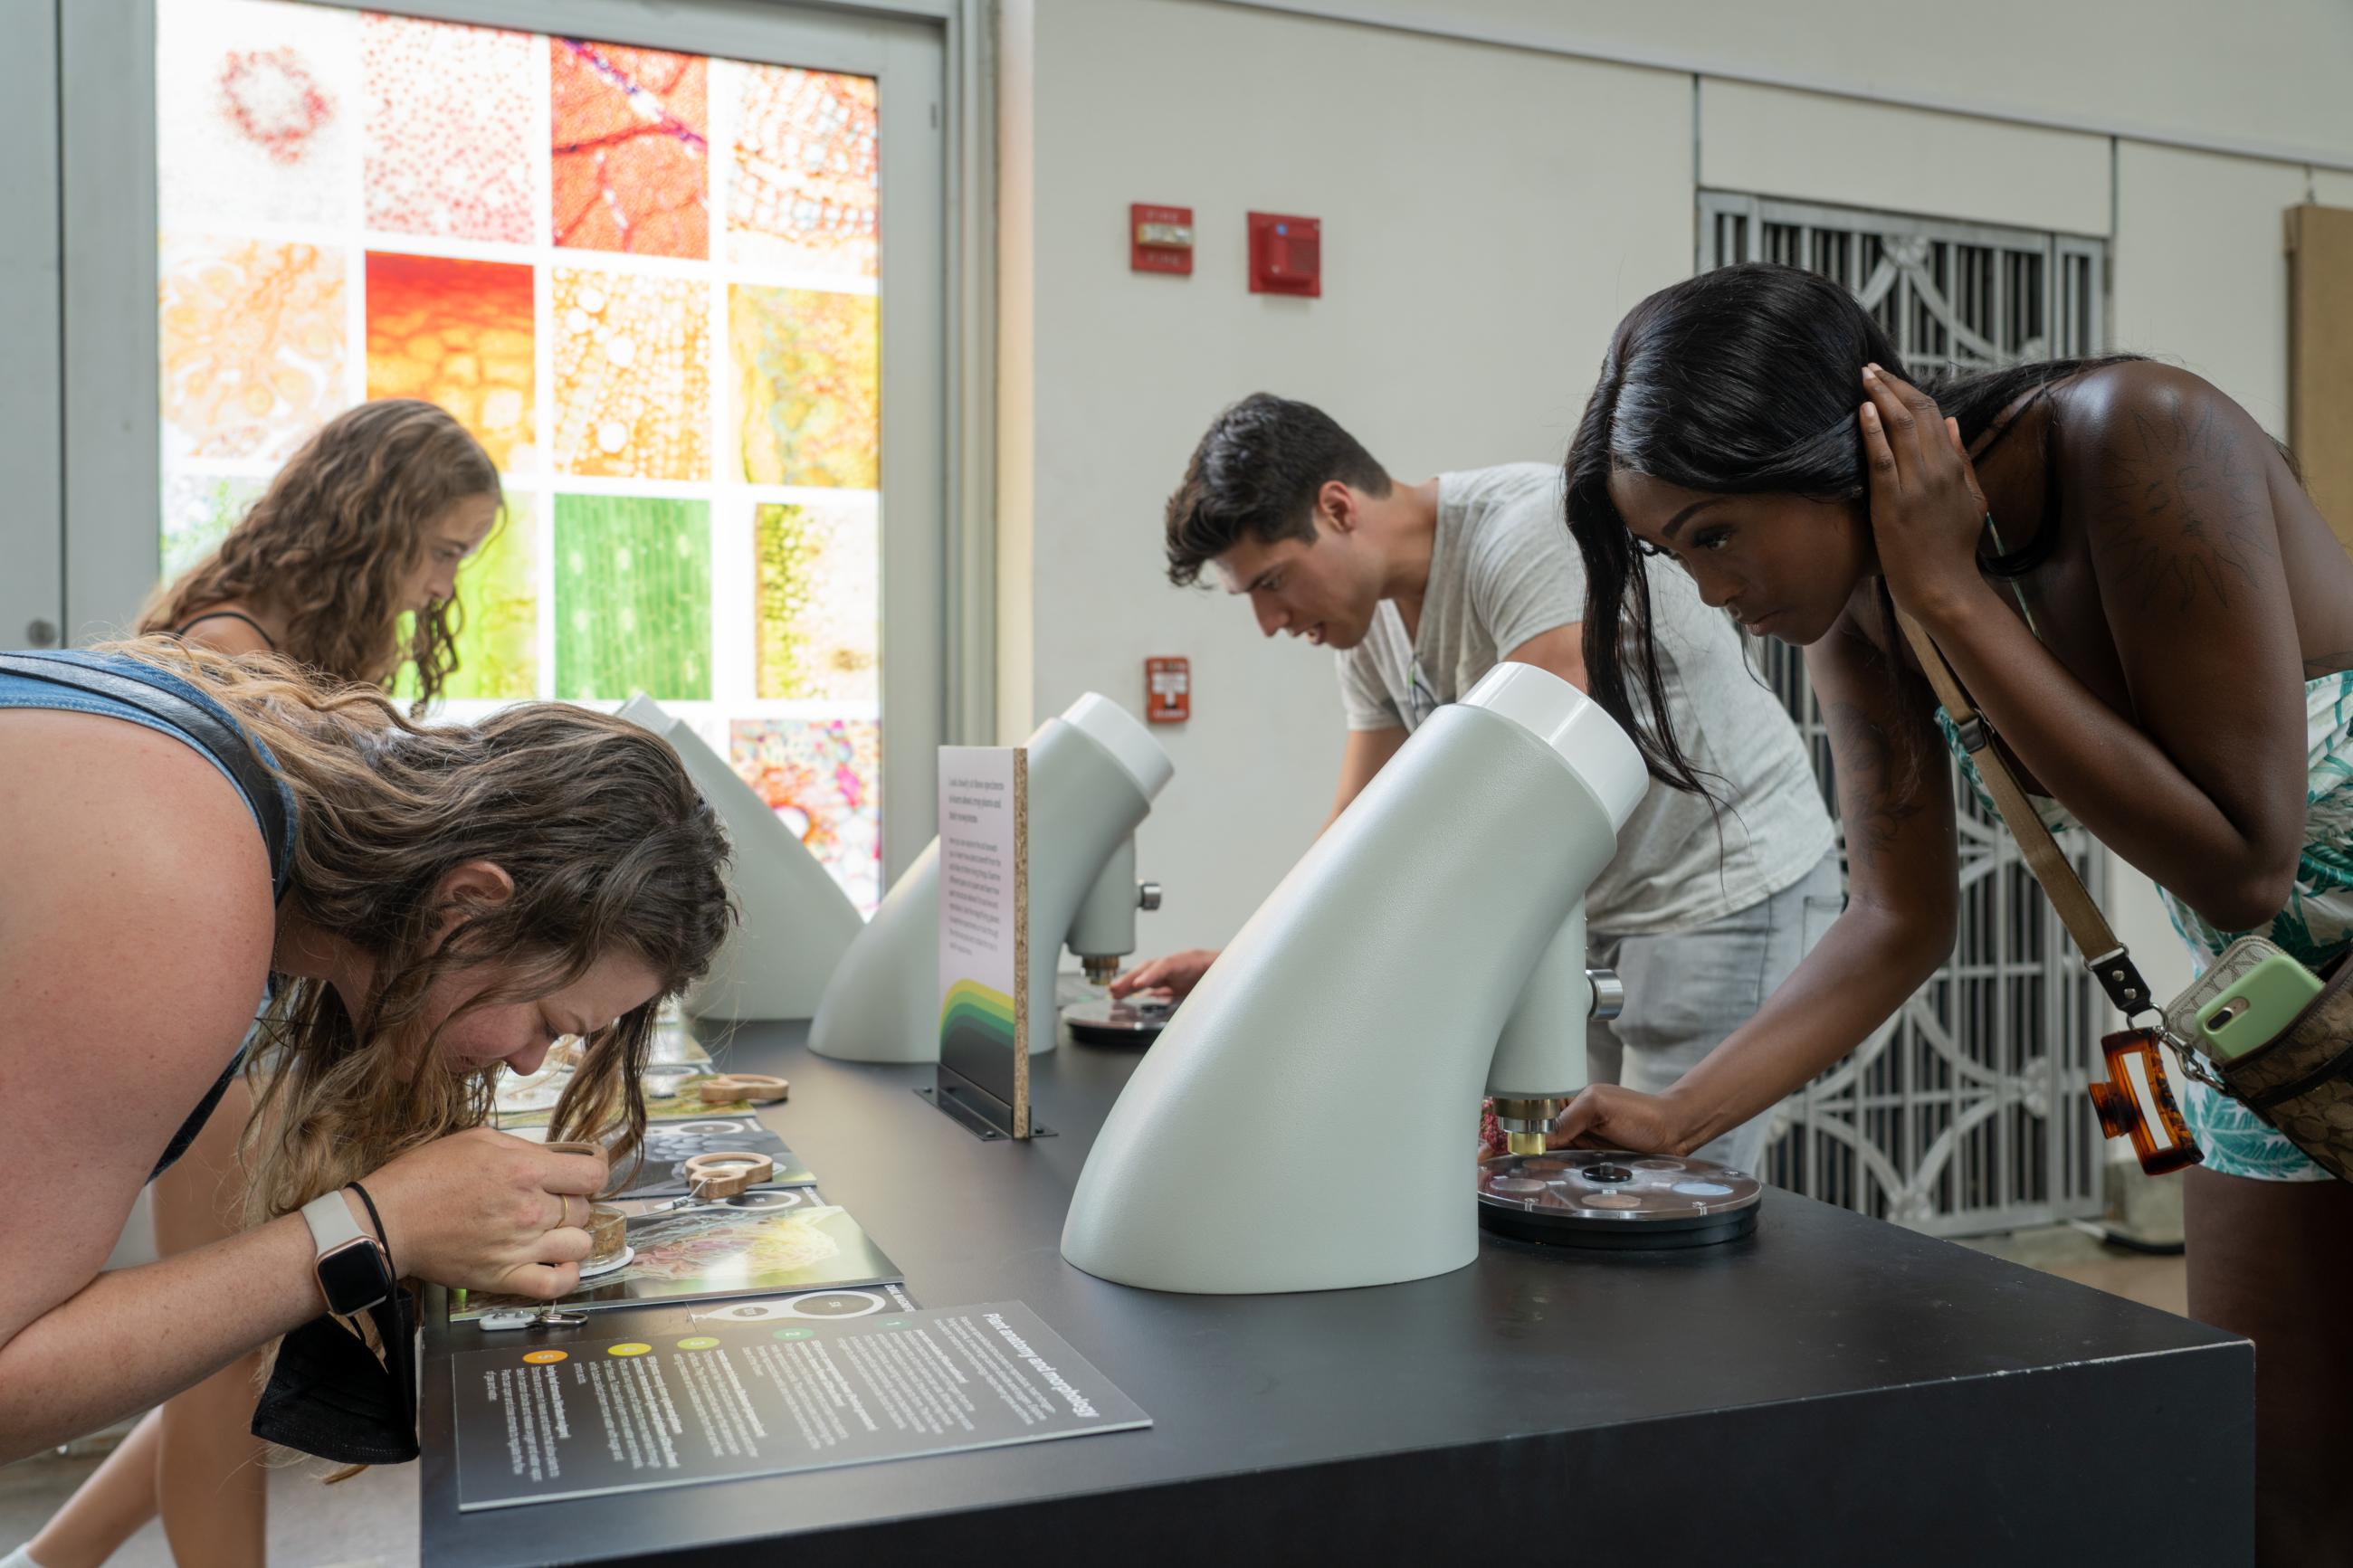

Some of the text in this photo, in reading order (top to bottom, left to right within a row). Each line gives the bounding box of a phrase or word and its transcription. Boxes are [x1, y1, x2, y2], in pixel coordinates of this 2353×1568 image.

[983, 1313, 1099, 1418] Plant anatomy and morphology
